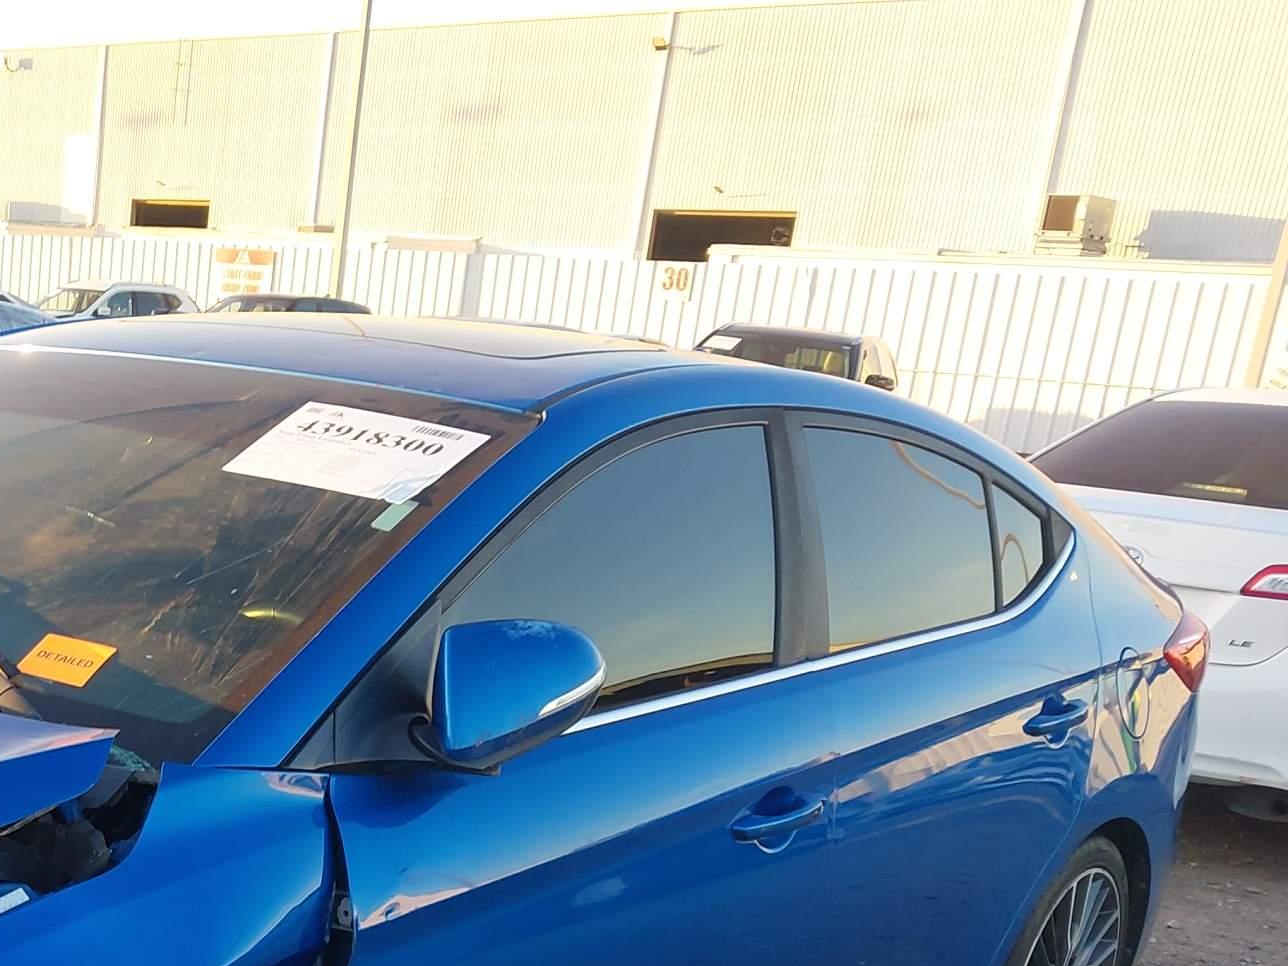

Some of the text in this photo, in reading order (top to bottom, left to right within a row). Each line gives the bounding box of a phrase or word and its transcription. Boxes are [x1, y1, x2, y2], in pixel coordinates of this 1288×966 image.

[662, 266, 690, 291] 30
[295, 419, 445, 457] 43918300
[1228, 639, 1255, 648] LE
[37, 650, 94, 668] DETAILED
